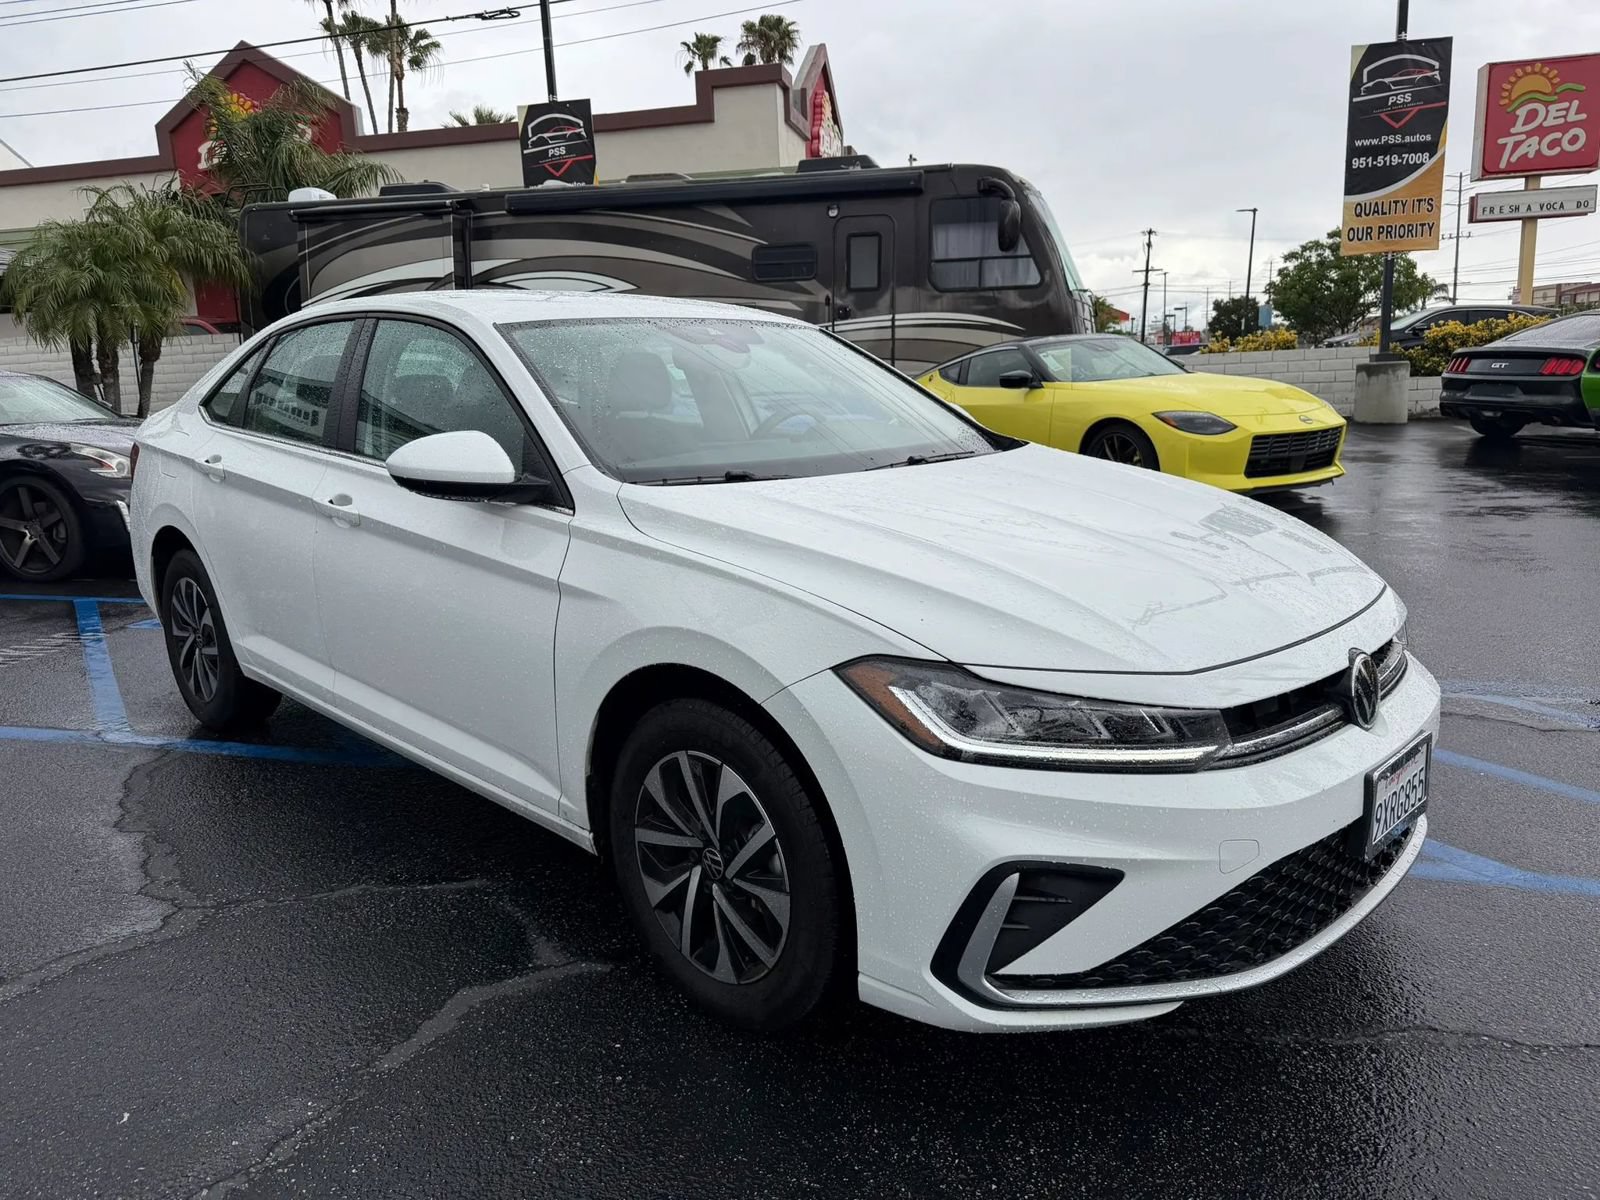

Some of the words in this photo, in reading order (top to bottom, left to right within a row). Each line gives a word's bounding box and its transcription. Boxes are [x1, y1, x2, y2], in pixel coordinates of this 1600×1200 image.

[1387, 93, 1412, 106] PSS
[1510, 100, 1587, 134] DEL
[1354, 133, 1432, 147] www.PSS.autos
[1497, 127, 1586, 169] TACO
[548, 146, 566, 157] PSS
[1352, 152, 1430, 169] 951-519-7008
[1354, 199, 1408, 218] QUALITY
[1412, 197, 1434, 213] IT'S
[1347, 226, 1373, 242] OUR
[1377, 222, 1435, 240] PRIORITY
[1373, 766, 1424, 842] 9XRG855
